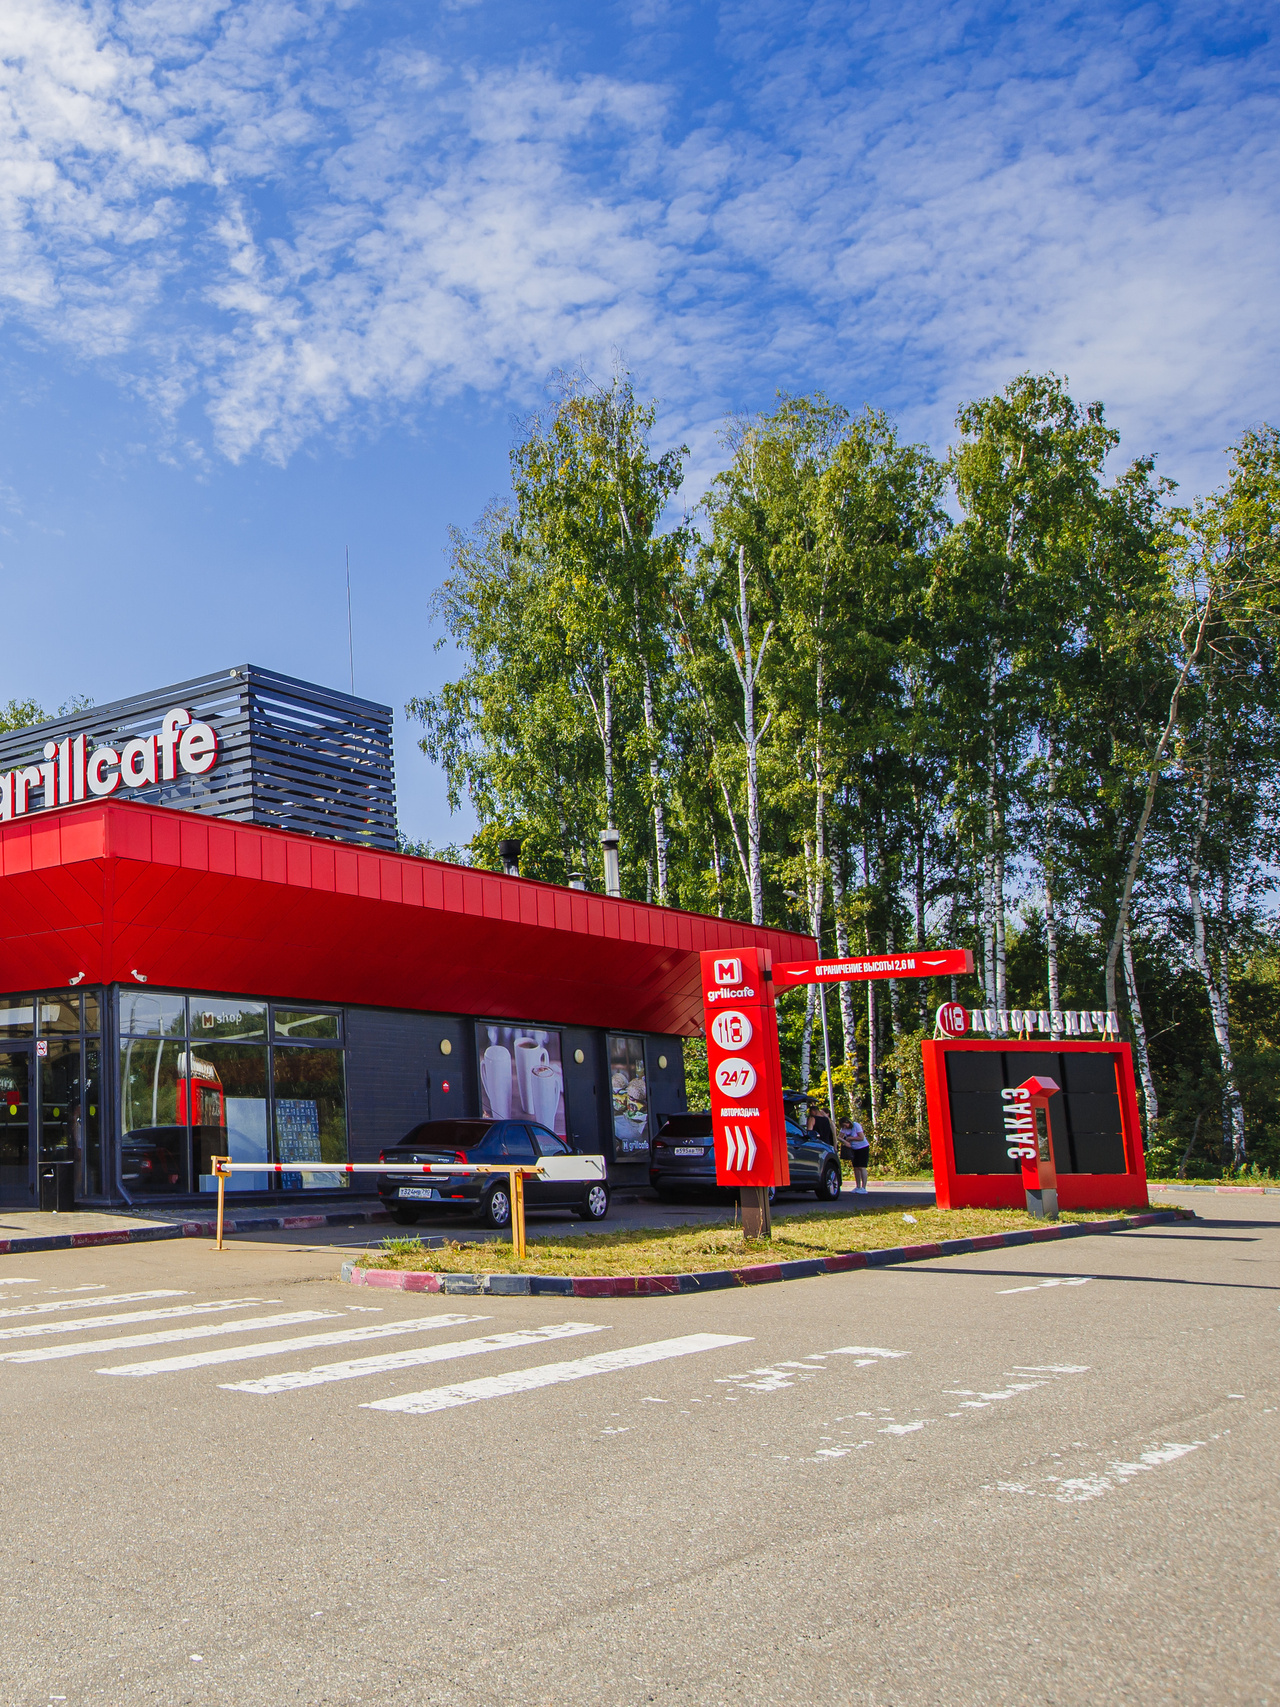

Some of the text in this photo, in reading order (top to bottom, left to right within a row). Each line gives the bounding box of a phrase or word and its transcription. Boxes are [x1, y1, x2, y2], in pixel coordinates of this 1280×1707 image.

[815, 958, 916, 976] ОГРАНИЧЕНИЕ ВЫСОТЫ 2,6 М
[707, 986, 755, 1002] grillcafe
[216, 1011, 243, 1026] shop
[971, 1008, 1120, 1036] АВТОРАЗДАЧА
[720, 1067, 750, 1088] 24/7
[721, 1107, 760, 1118] АВТОРАЗДАЧА
[1000, 1088, 1037, 1160] ЗАКАЗ
